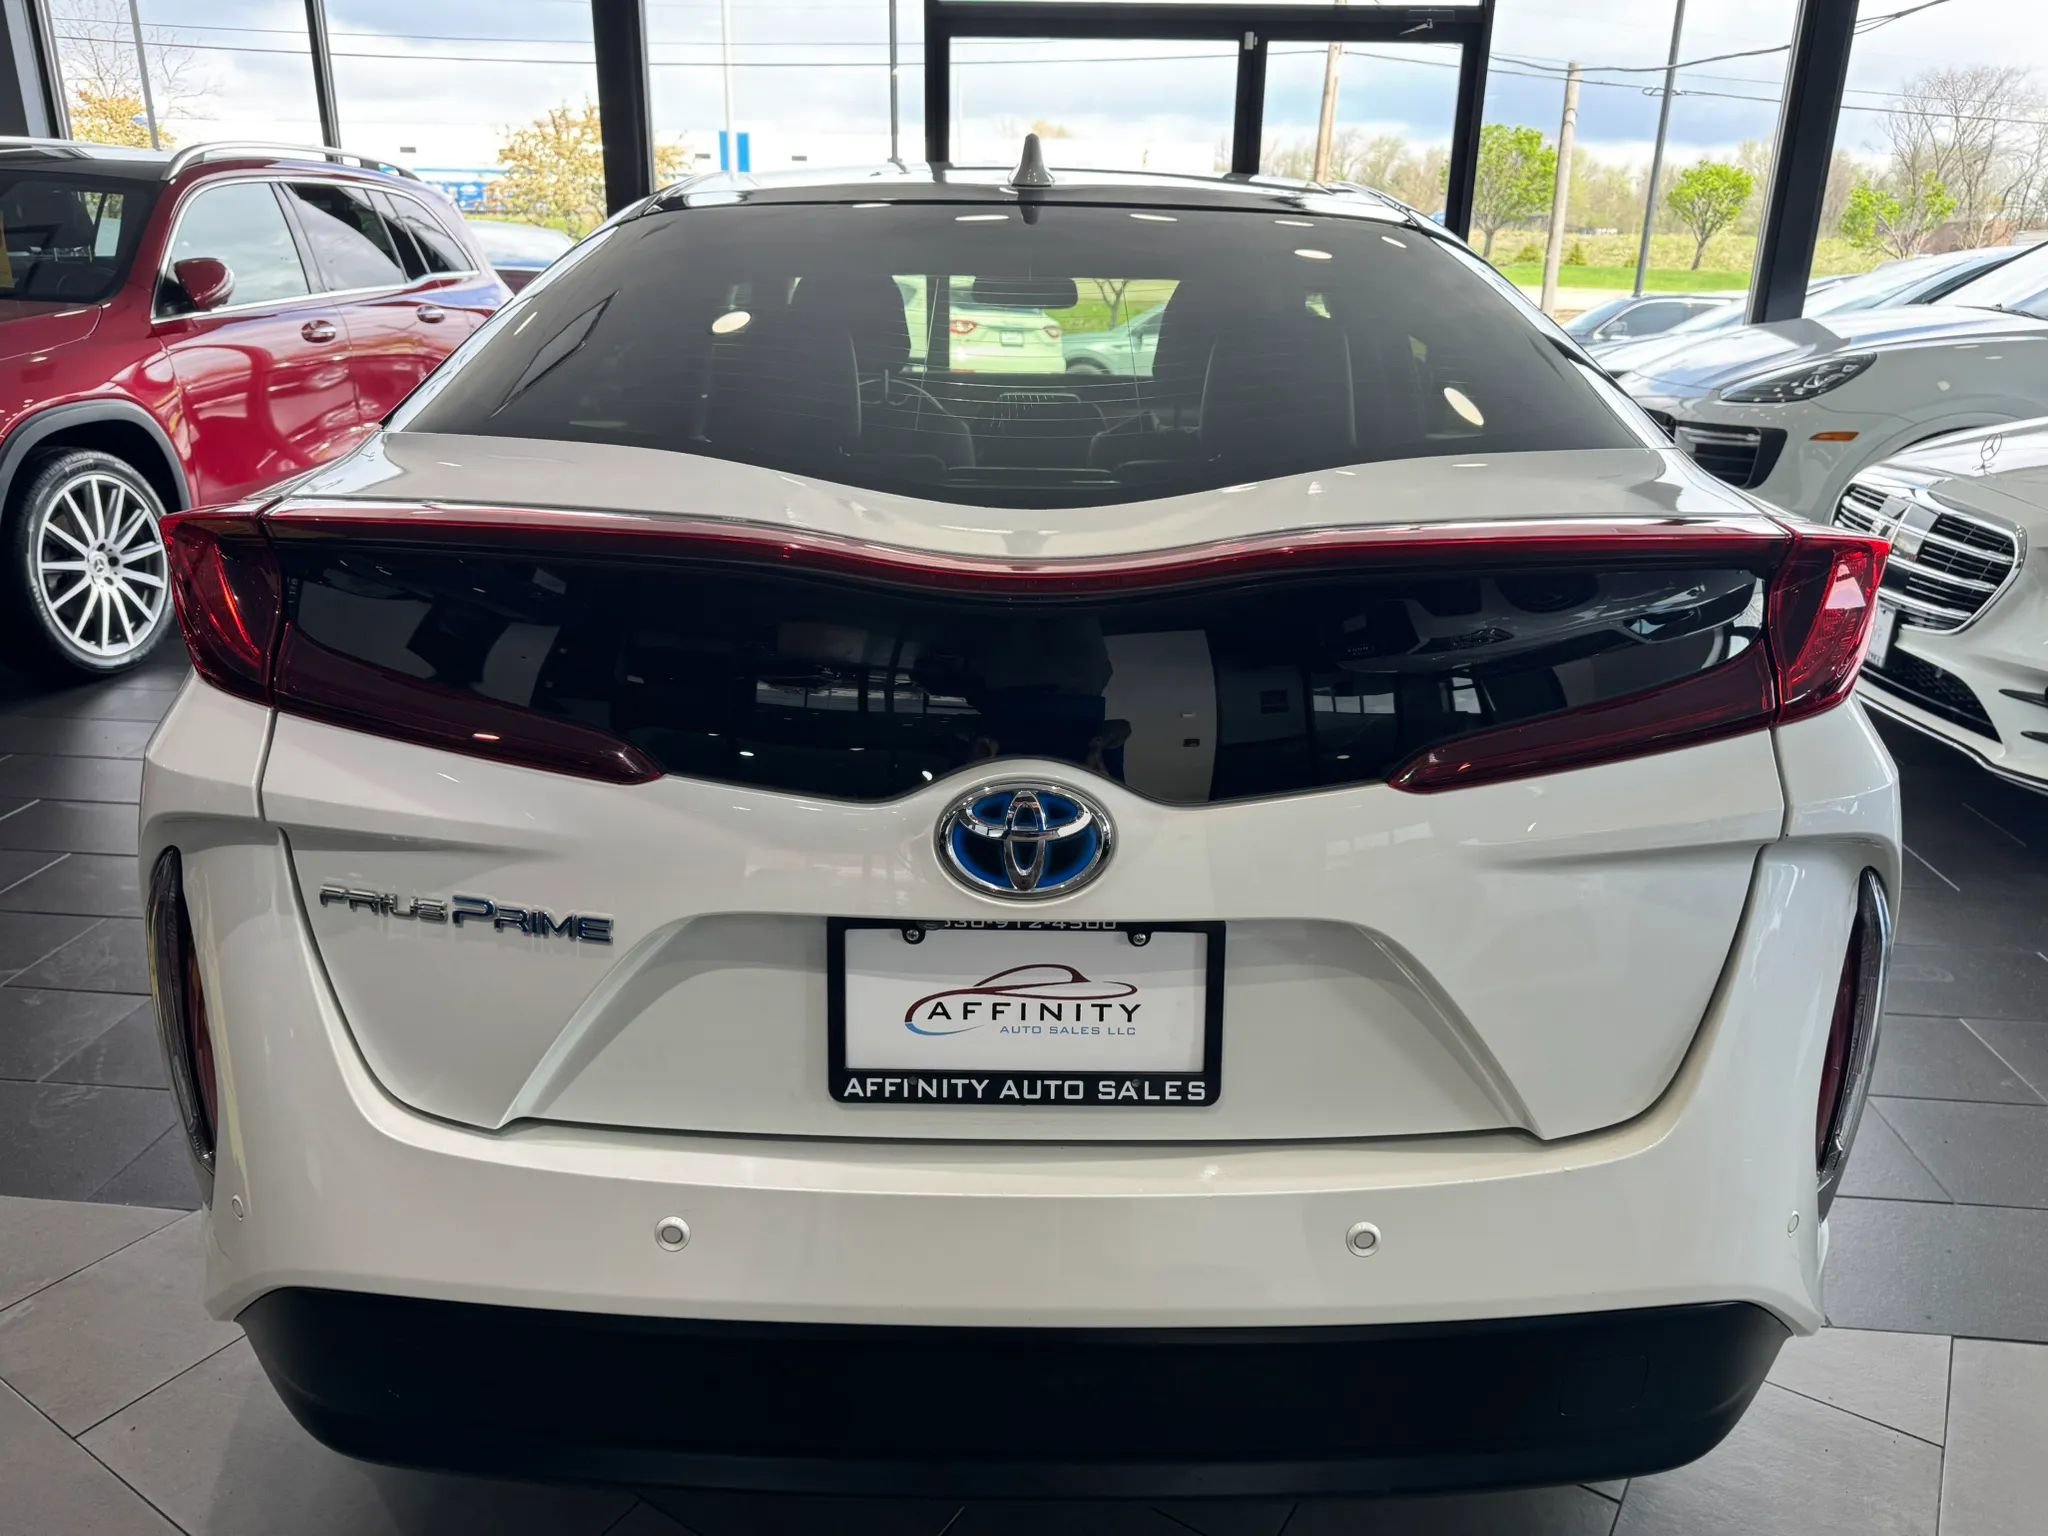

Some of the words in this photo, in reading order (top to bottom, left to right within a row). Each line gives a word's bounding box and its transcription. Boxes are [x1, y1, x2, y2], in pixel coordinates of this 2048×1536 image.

[319, 883, 449, 923] PRIUS
[452, 893, 615, 945] PRIME
[927, 1001, 1142, 1023] AFFINITY
[999, 1025, 1043, 1035] AUTO
[1049, 1025, 1101, 1036] SALES
[1107, 1026, 1137, 1036] LLC
[843, 1077, 990, 1099] AFFINITY
[999, 1078, 1085, 1101] AUTO
[1097, 1079, 1206, 1102] SALES
